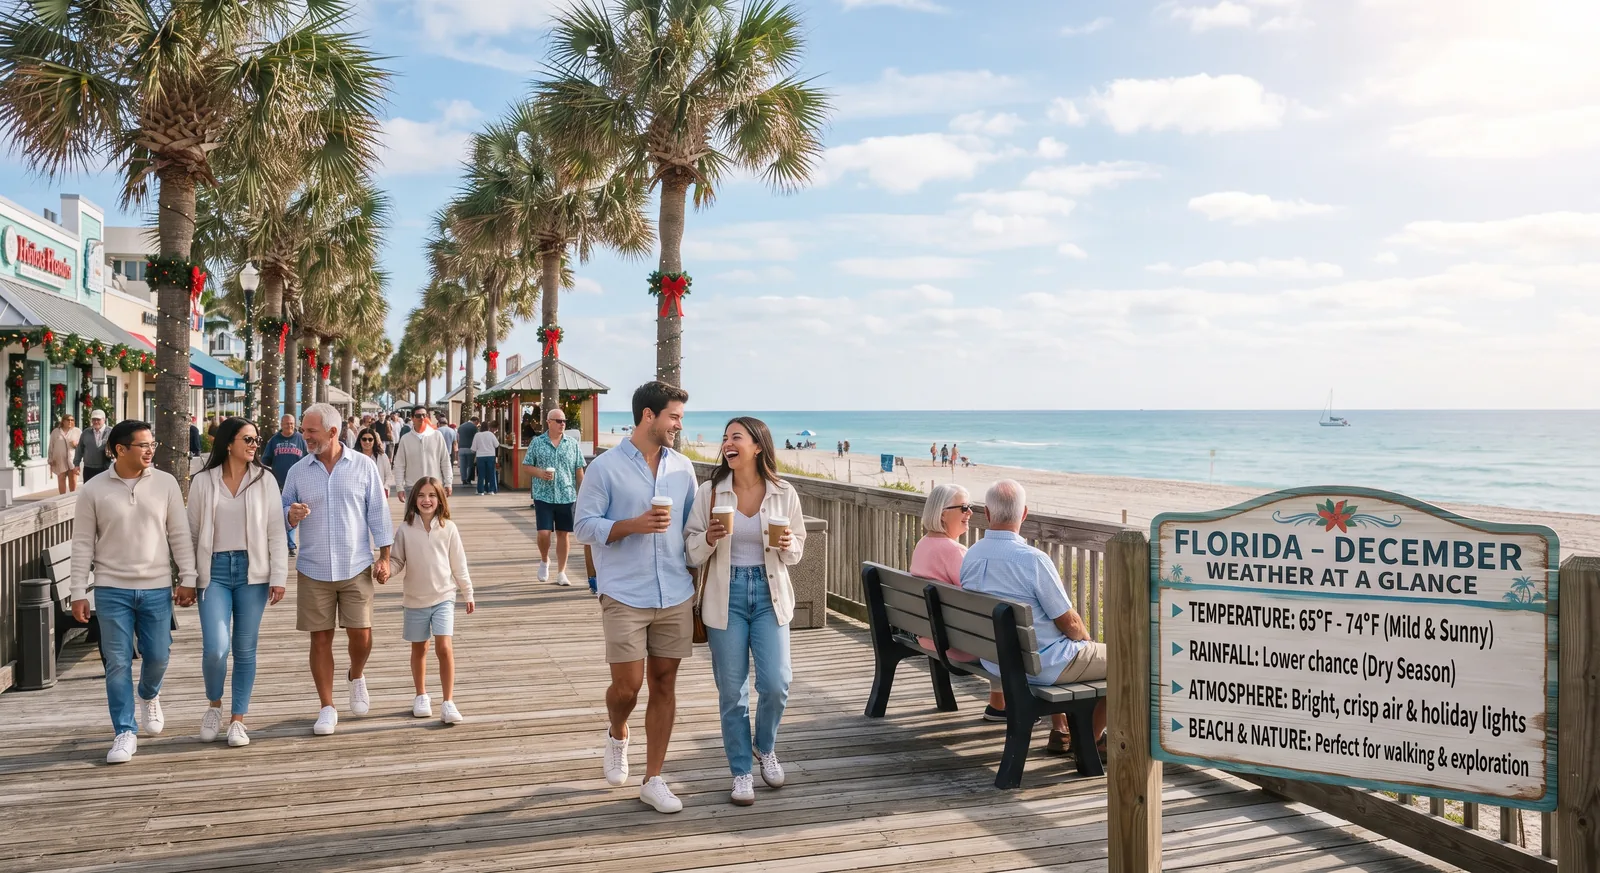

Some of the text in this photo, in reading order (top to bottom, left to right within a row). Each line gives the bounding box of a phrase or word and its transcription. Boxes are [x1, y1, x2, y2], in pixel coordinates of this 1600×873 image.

[1175, 529, 1303, 561] FLORIDA
[1334, 536, 1523, 572] DECEMBER
[1206, 561, 1478, 595] WEATHER AT A GLANCE
[1188, 600, 1296, 631] TEMPERATURE:
[1298, 608, 1333, 633] 65°F
[1345, 612, 1380, 636] 74°F
[1383, 612, 1421, 643] (Mild
[1424, 617, 1436, 641] &
[1439, 618, 1494, 651] Sunny)
[1189, 639, 1456, 689] RAINFALL: Lower chance (Dry Season)
[1188, 678, 1527, 738] ATMOSPHERE: Bright, crisp air & holiday lights
[1188, 717, 1530, 778] BEACH & NATURE: Perfect for walking & exploration
